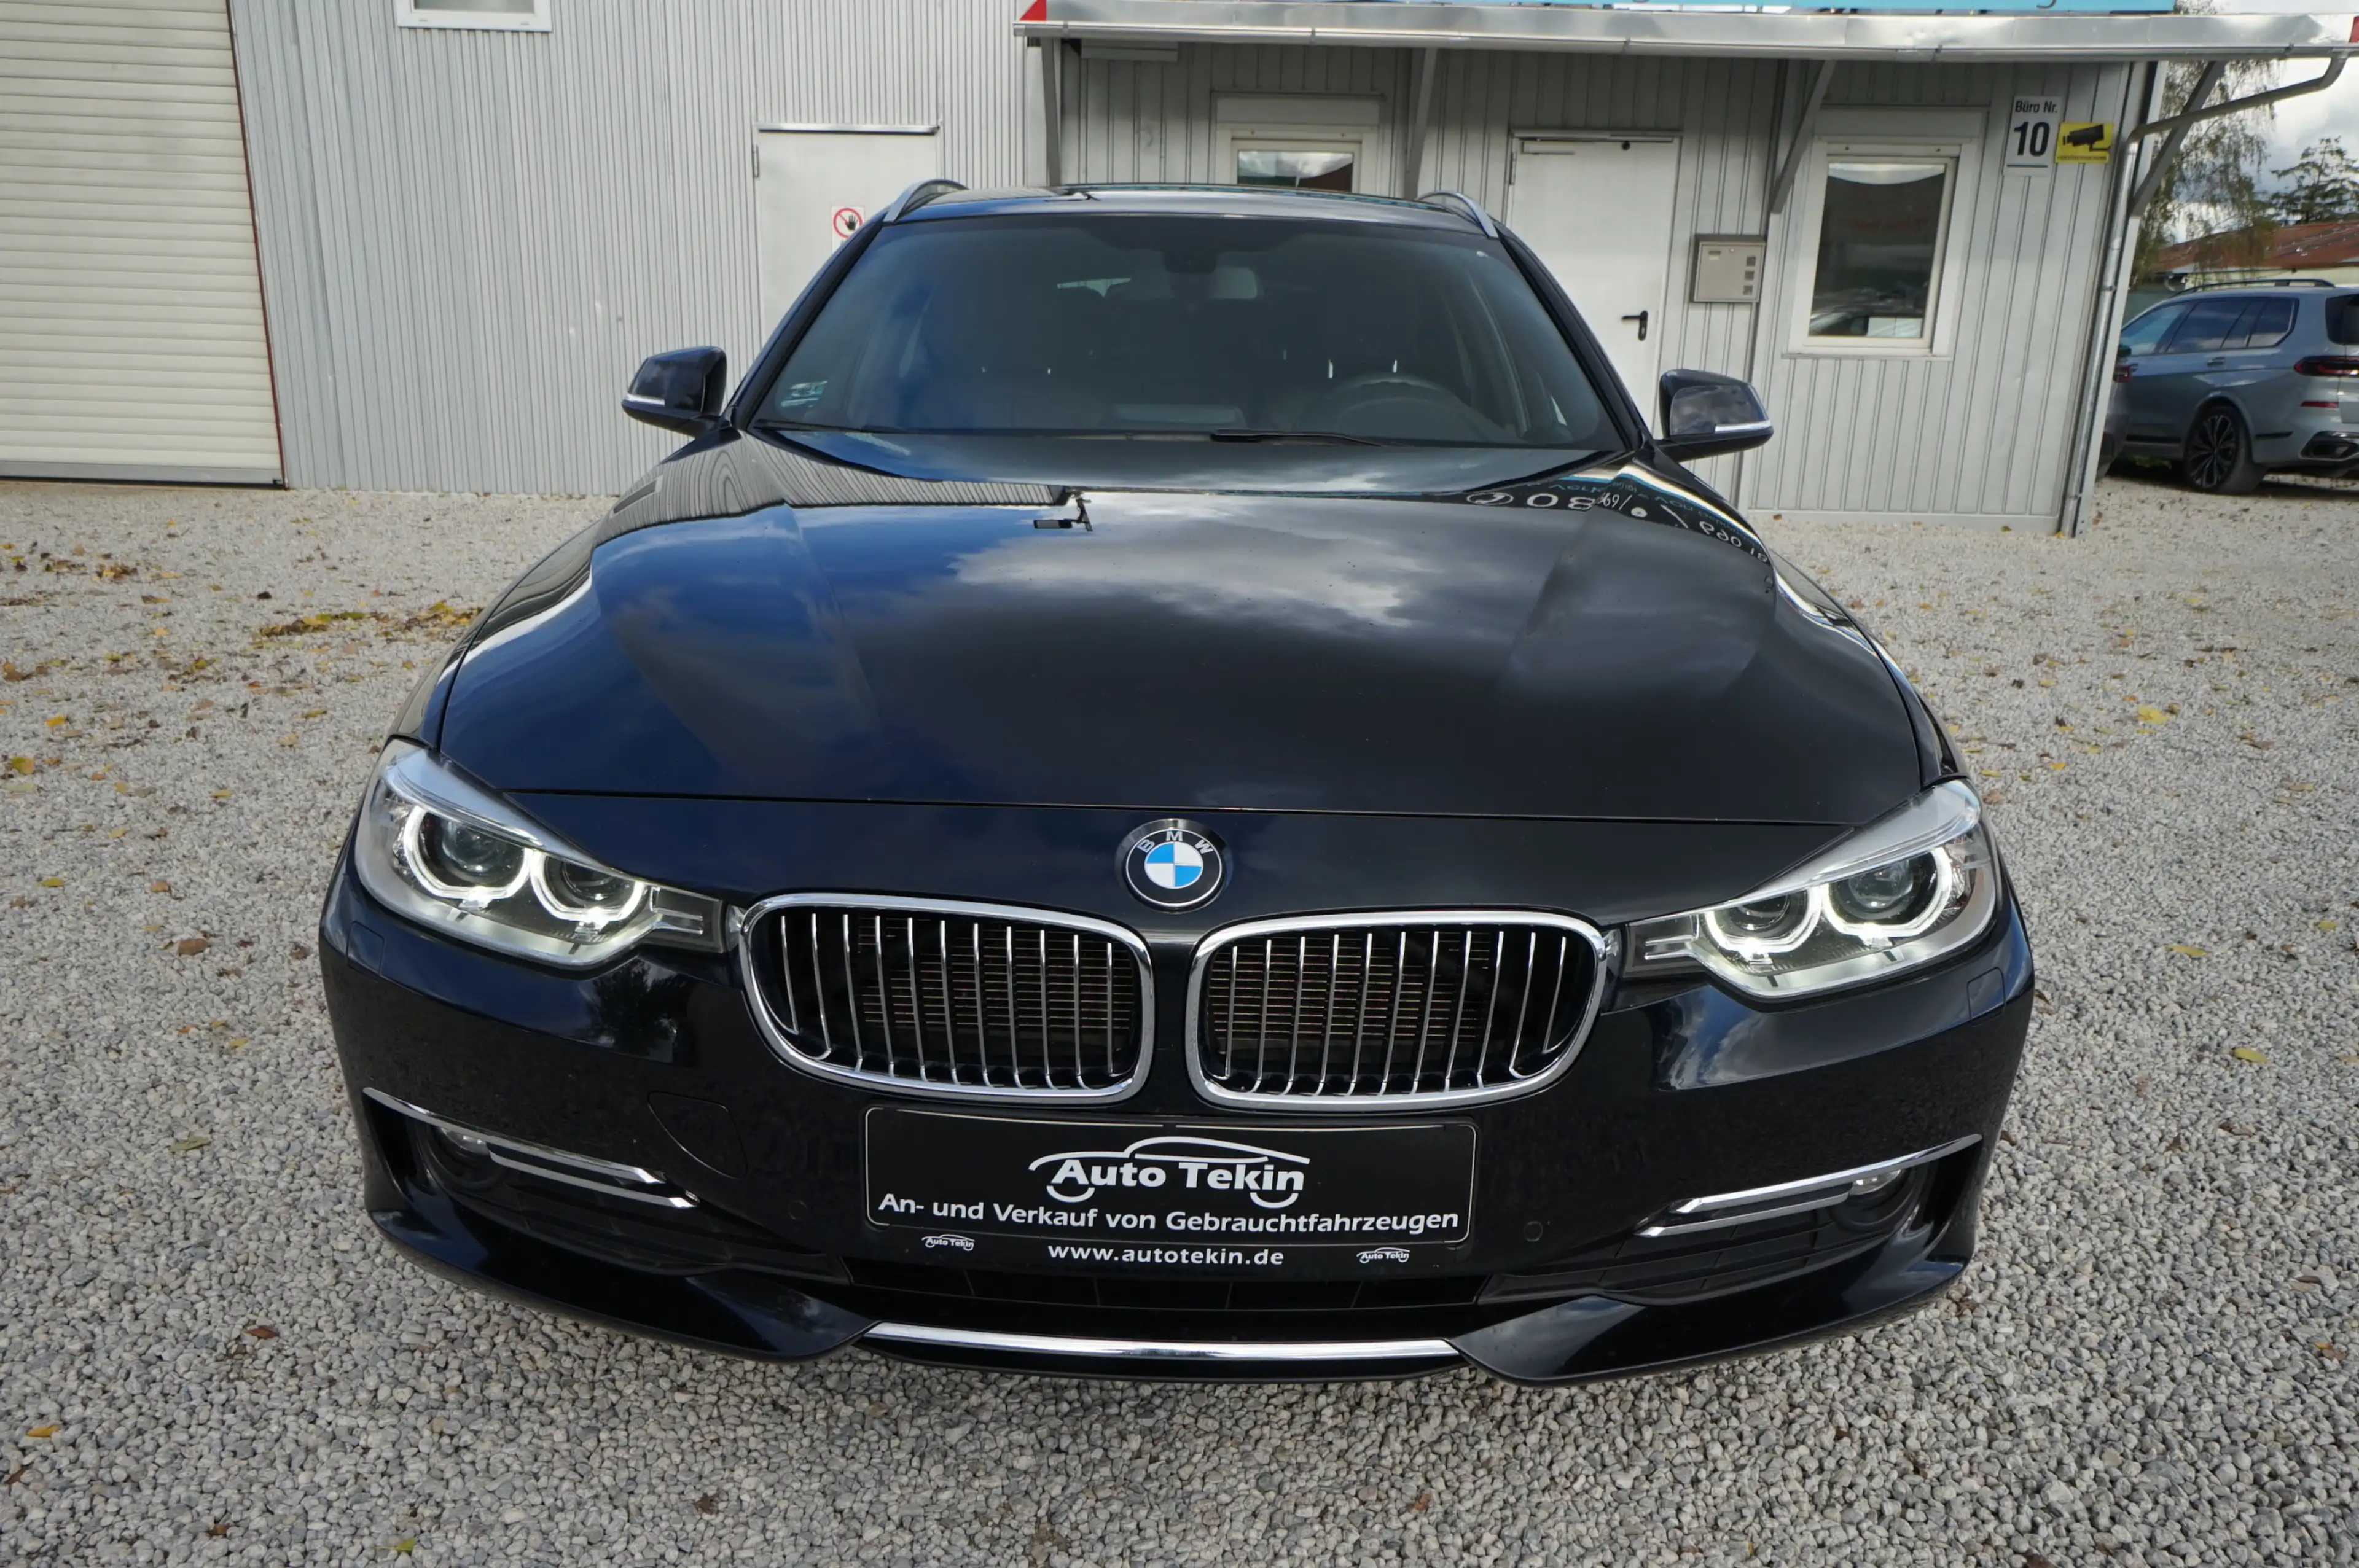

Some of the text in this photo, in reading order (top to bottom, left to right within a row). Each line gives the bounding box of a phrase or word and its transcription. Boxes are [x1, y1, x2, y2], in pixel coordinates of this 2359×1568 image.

[2015, 101, 2057, 113] Büro Nr.
[2013, 122, 2051, 157] 10
[1136, 830, 1214, 854] BMW
[1050, 1158, 1304, 1191] Auto Tekin
[878, 1193, 1458, 1235] An- und Verkauf von Gebrauchtfahrzeugen
[926, 1238, 974, 1247] Auto Tekin
[1048, 1246, 1284, 1265] www.autotekin.de
